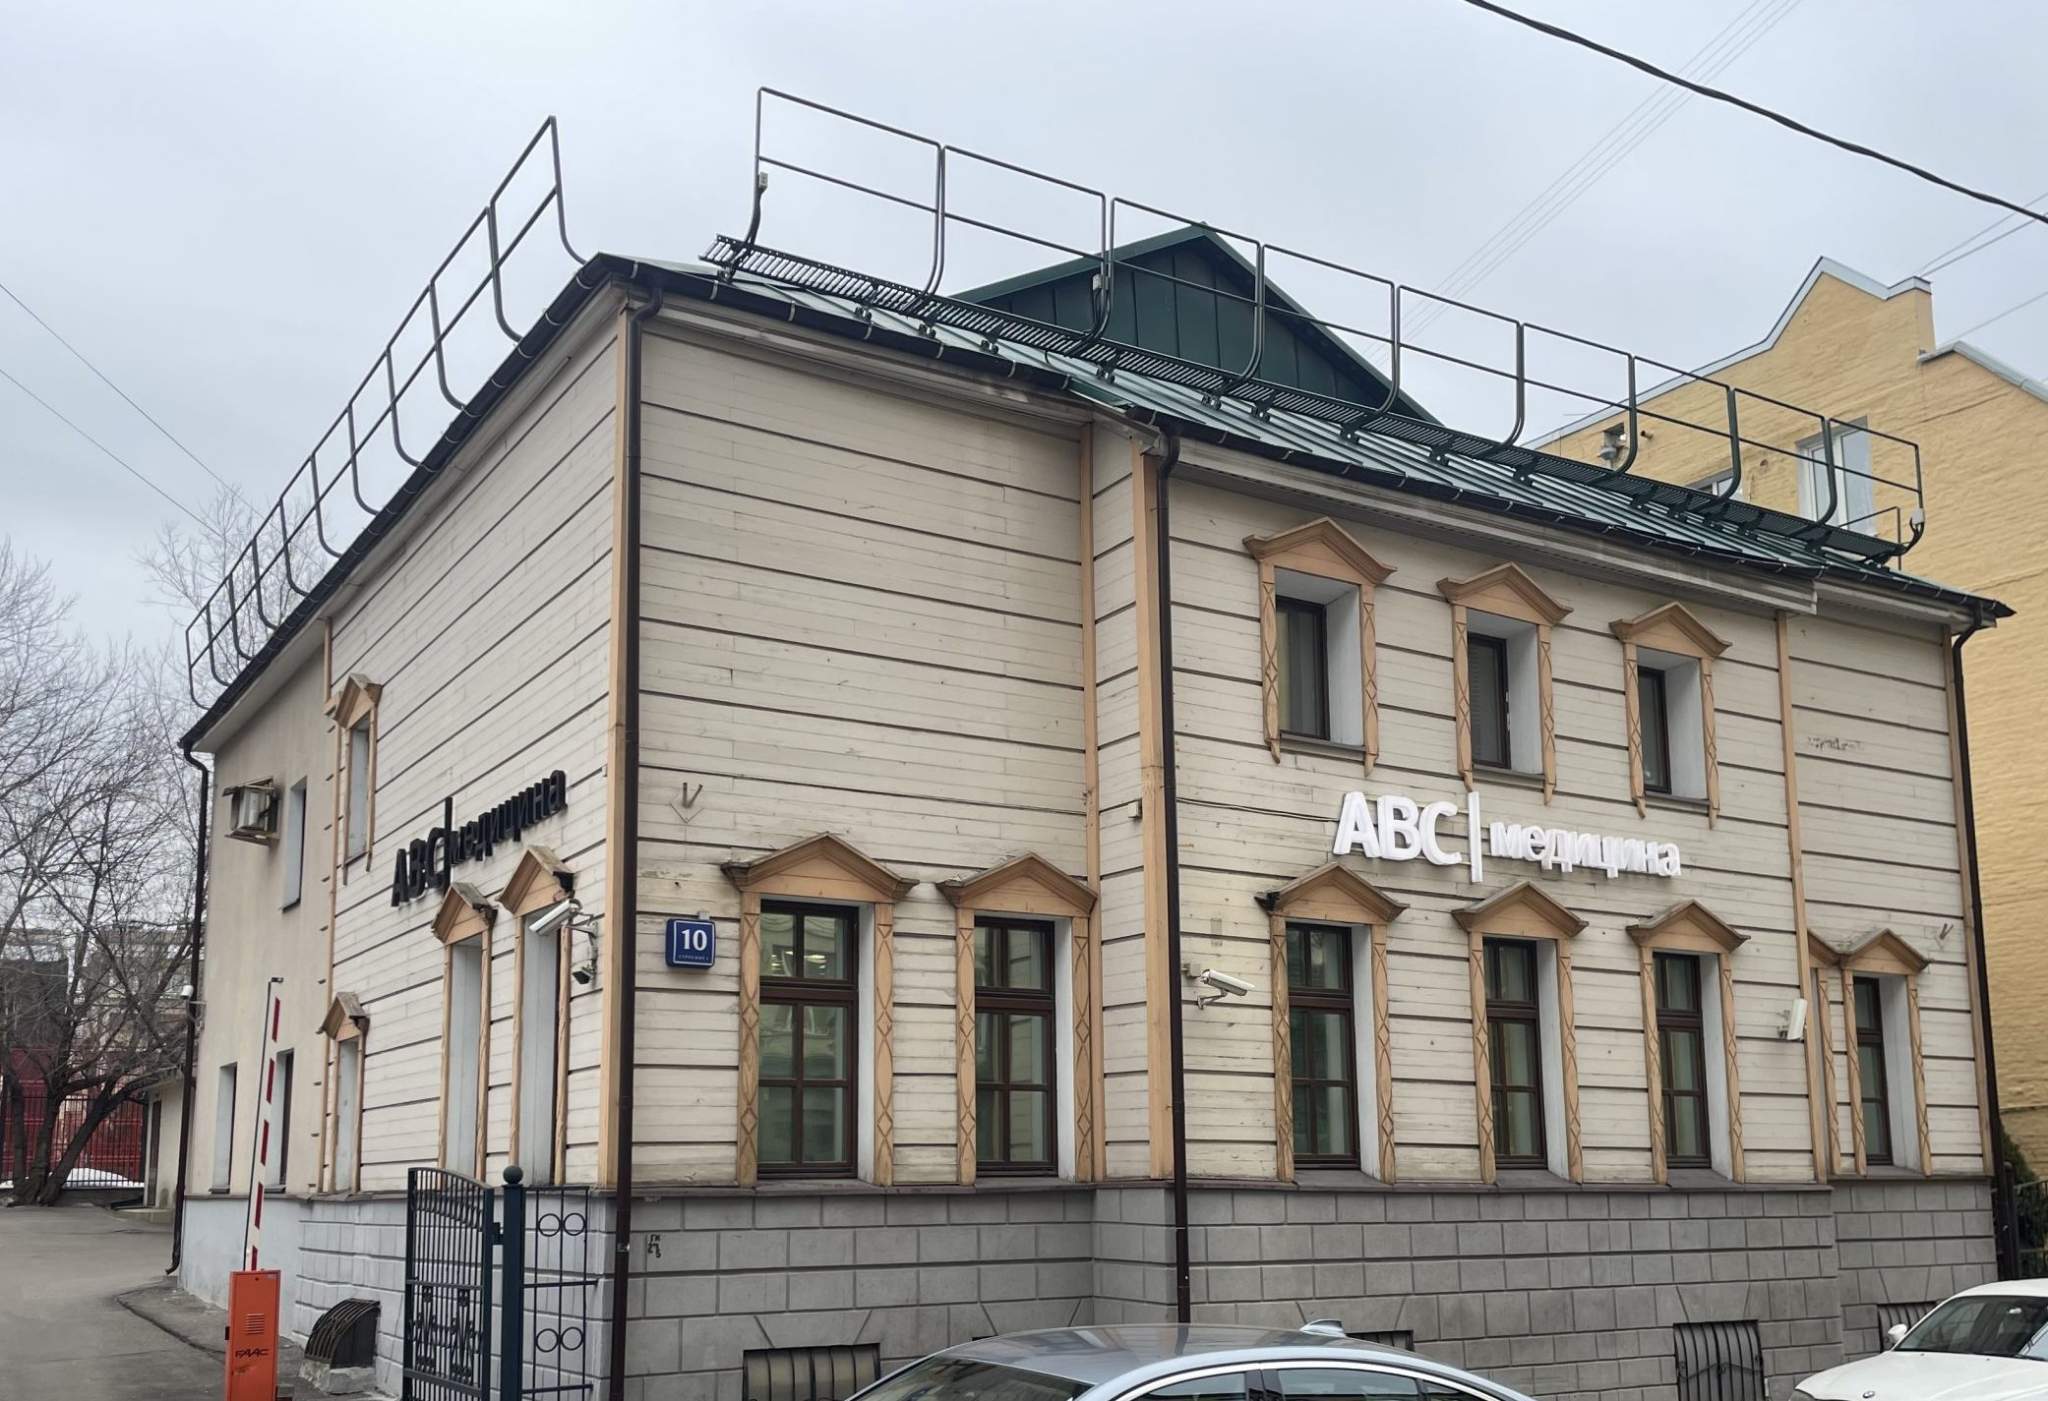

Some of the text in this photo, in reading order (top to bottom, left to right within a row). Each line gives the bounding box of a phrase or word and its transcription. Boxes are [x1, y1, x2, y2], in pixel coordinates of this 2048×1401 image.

[1490, 822, 1681, 878] медицина
[681, 929, 708, 951] 10
[235, 1348, 268, 1358] FAAC
